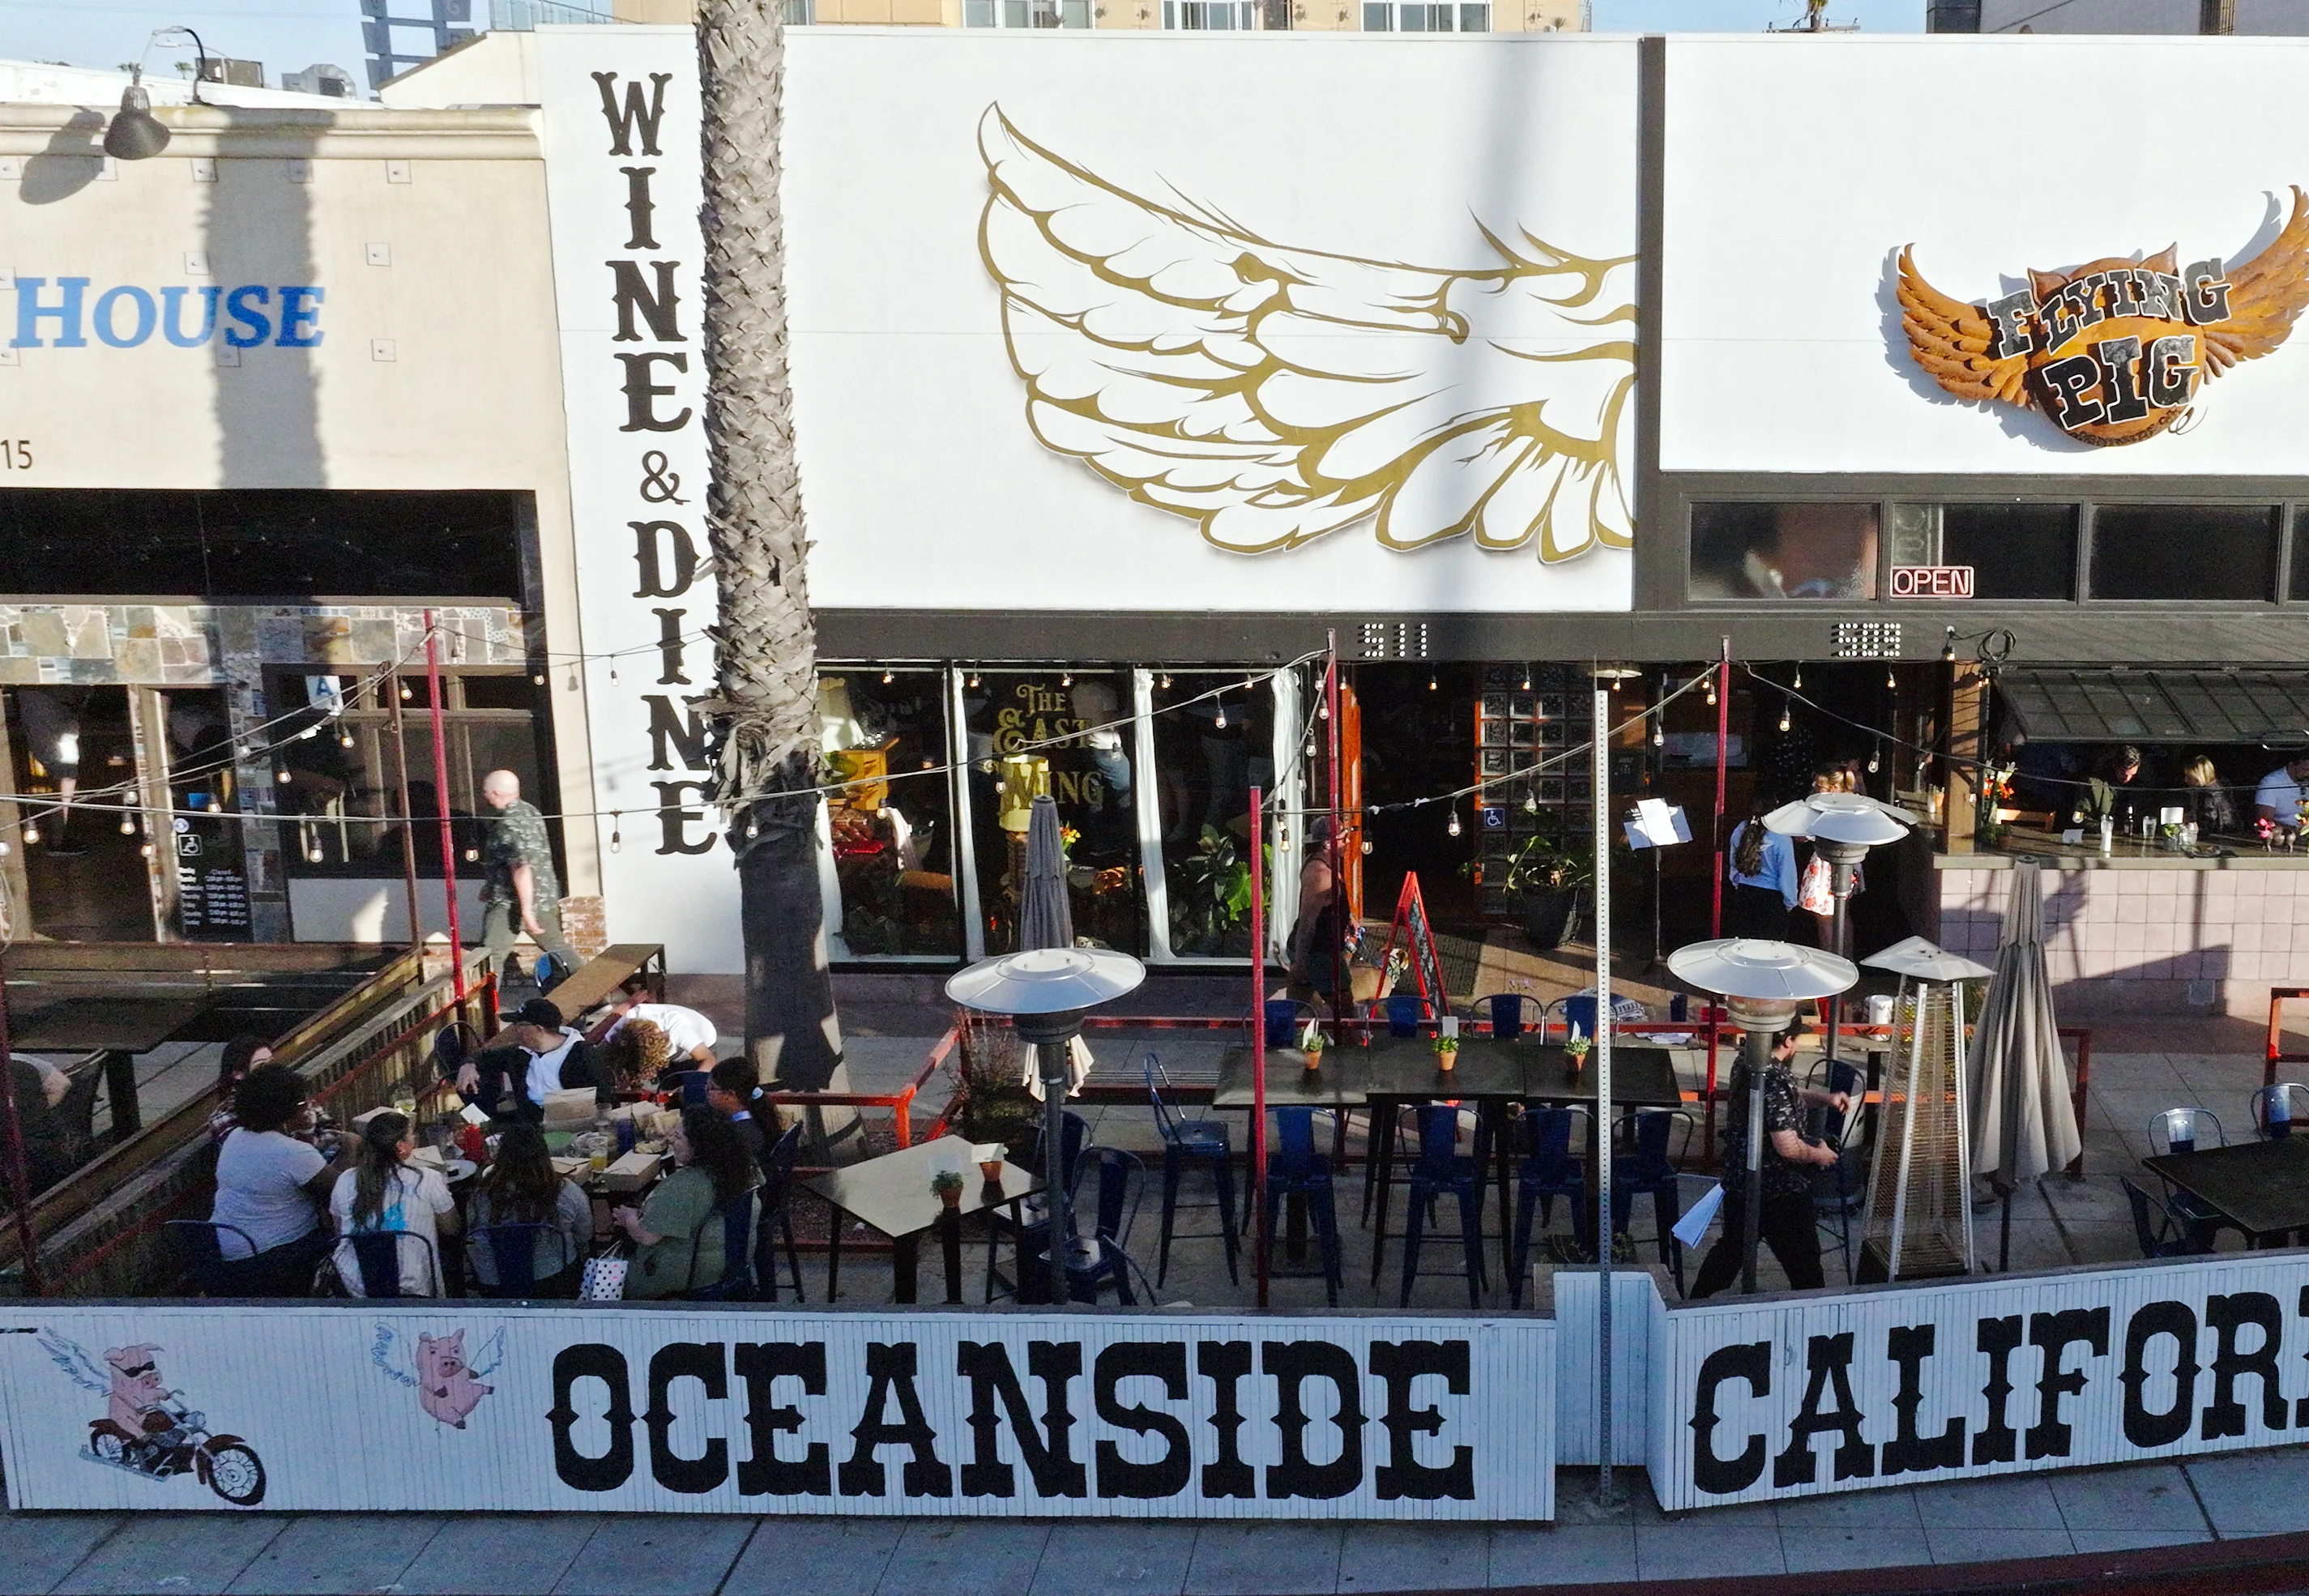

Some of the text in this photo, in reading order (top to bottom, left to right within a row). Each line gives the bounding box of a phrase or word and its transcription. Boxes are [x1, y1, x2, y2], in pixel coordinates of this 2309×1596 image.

[10, 277, 326, 348] HOUSE
[1987, 258, 2231, 360] FLYING
[2042, 335, 2199, 431] PIG
[591, 71, 718, 856] WINE & DINE
[1893, 570, 1970, 594] OPEN
[1364, 623, 1427, 657] 511
[1838, 623, 1901, 657] 509
[317, 677, 333, 695] A
[1016, 683, 1066, 717] THE
[993, 708, 1093, 754] EAST
[985, 758, 1104, 814] WING
[1688, 1285, 2309, 1494] CALIFOR
[545, 1341, 1475, 1500] OCEANSIDE
